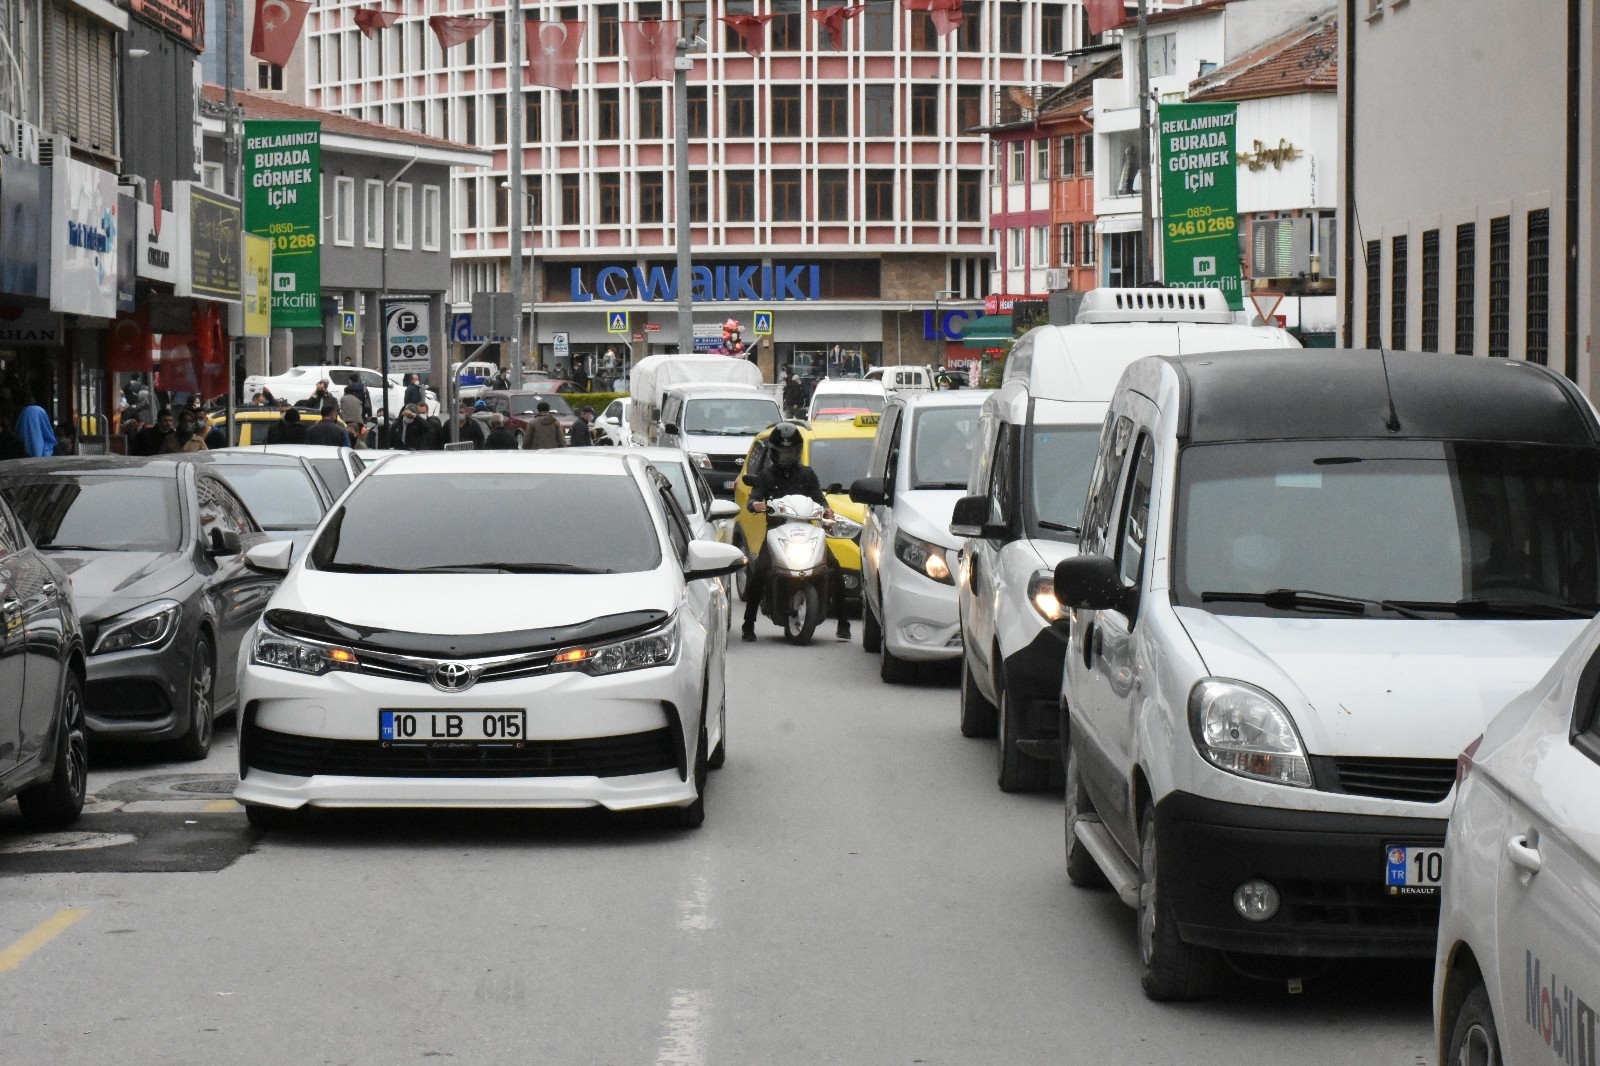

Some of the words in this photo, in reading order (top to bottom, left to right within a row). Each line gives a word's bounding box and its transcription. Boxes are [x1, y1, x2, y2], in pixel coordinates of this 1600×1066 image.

[1162, 113, 1234, 134] REKLAMINIZI
[247, 132, 318, 150] REKLAMINIZI
[1170, 131, 1227, 153] BURADA
[254, 149, 310, 169] BURADA
[1169, 150, 1229, 172] GÖRMEK
[253, 168, 312, 188] GÖRMEK
[1184, 169, 1214, 193] İÇİN
[268, 186, 297, 210] İÇİN
[1187, 205, 1212, 219] 0850
[269, 222, 293, 234] 0850
[1169, 275, 1237, 291] markafili
[270, 293, 317, 308] arkafili
[924, 309, 984, 341] LC
[863, 416, 880, 424] TAK
[383, 727, 393, 735] TR
[394, 714, 417, 738] 10
[431, 714, 464, 738] LB
[482, 714, 521, 738] 015
[1390, 870, 1405, 879] TR
[1413, 851, 1443, 883] 10
